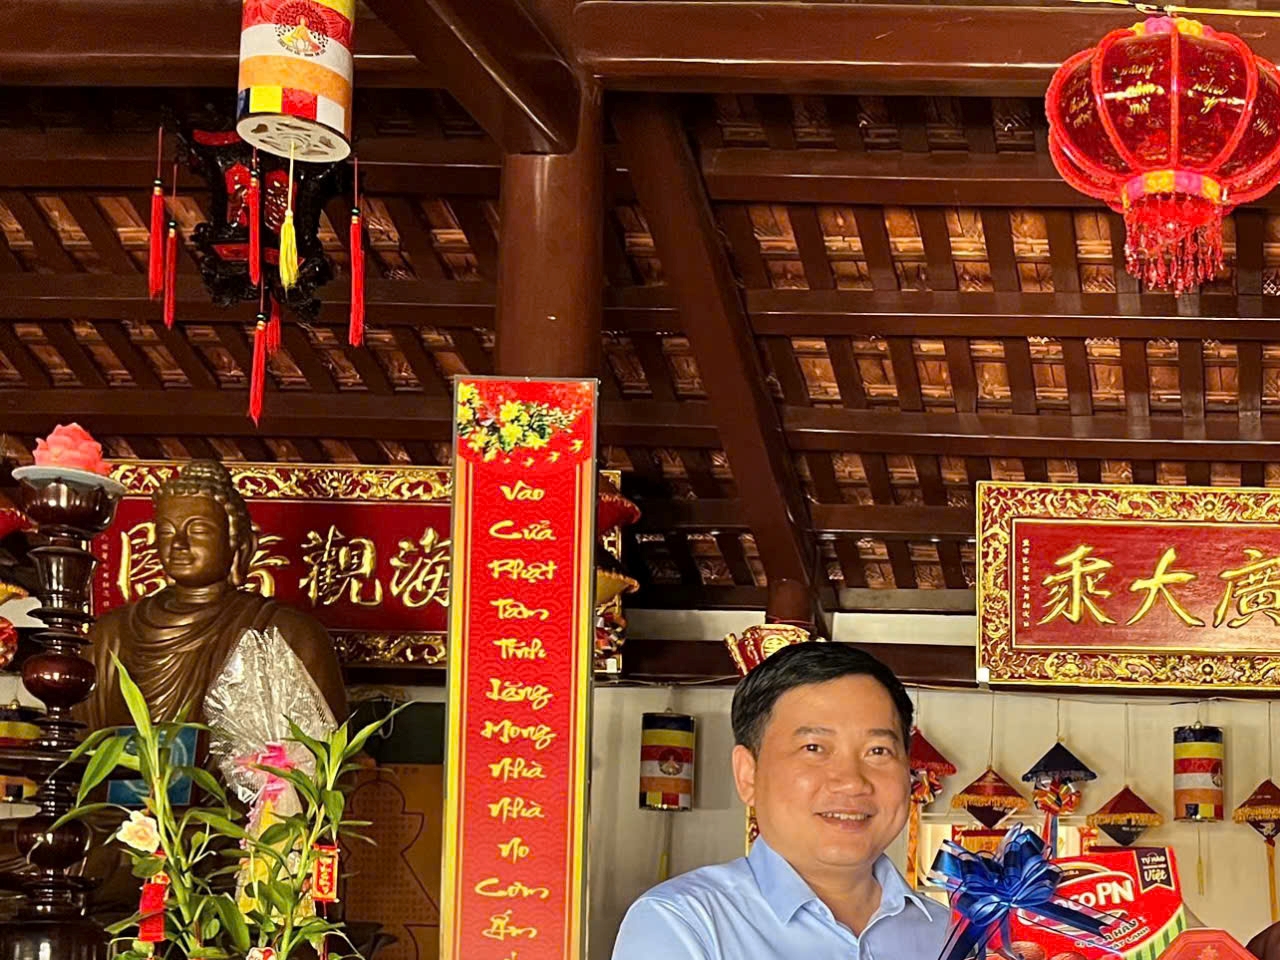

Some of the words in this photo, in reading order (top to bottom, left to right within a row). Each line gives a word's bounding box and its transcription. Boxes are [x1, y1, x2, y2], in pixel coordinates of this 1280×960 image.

[499, 479, 545, 501] Vào
[488, 519, 557, 541] Cửa
[487, 558, 558, 584] Phật
[489, 598, 550, 621] Tâm
[480, 719, 557, 751] Mong
[487, 757, 547, 783] Nhà
[487, 796, 545, 824] Nhà
[496, 836, 531, 864] No
[473, 876, 550, 900] Cơm
[1143, 869, 1168, 883] Việt
[480, 908, 539, 943] Ấm
